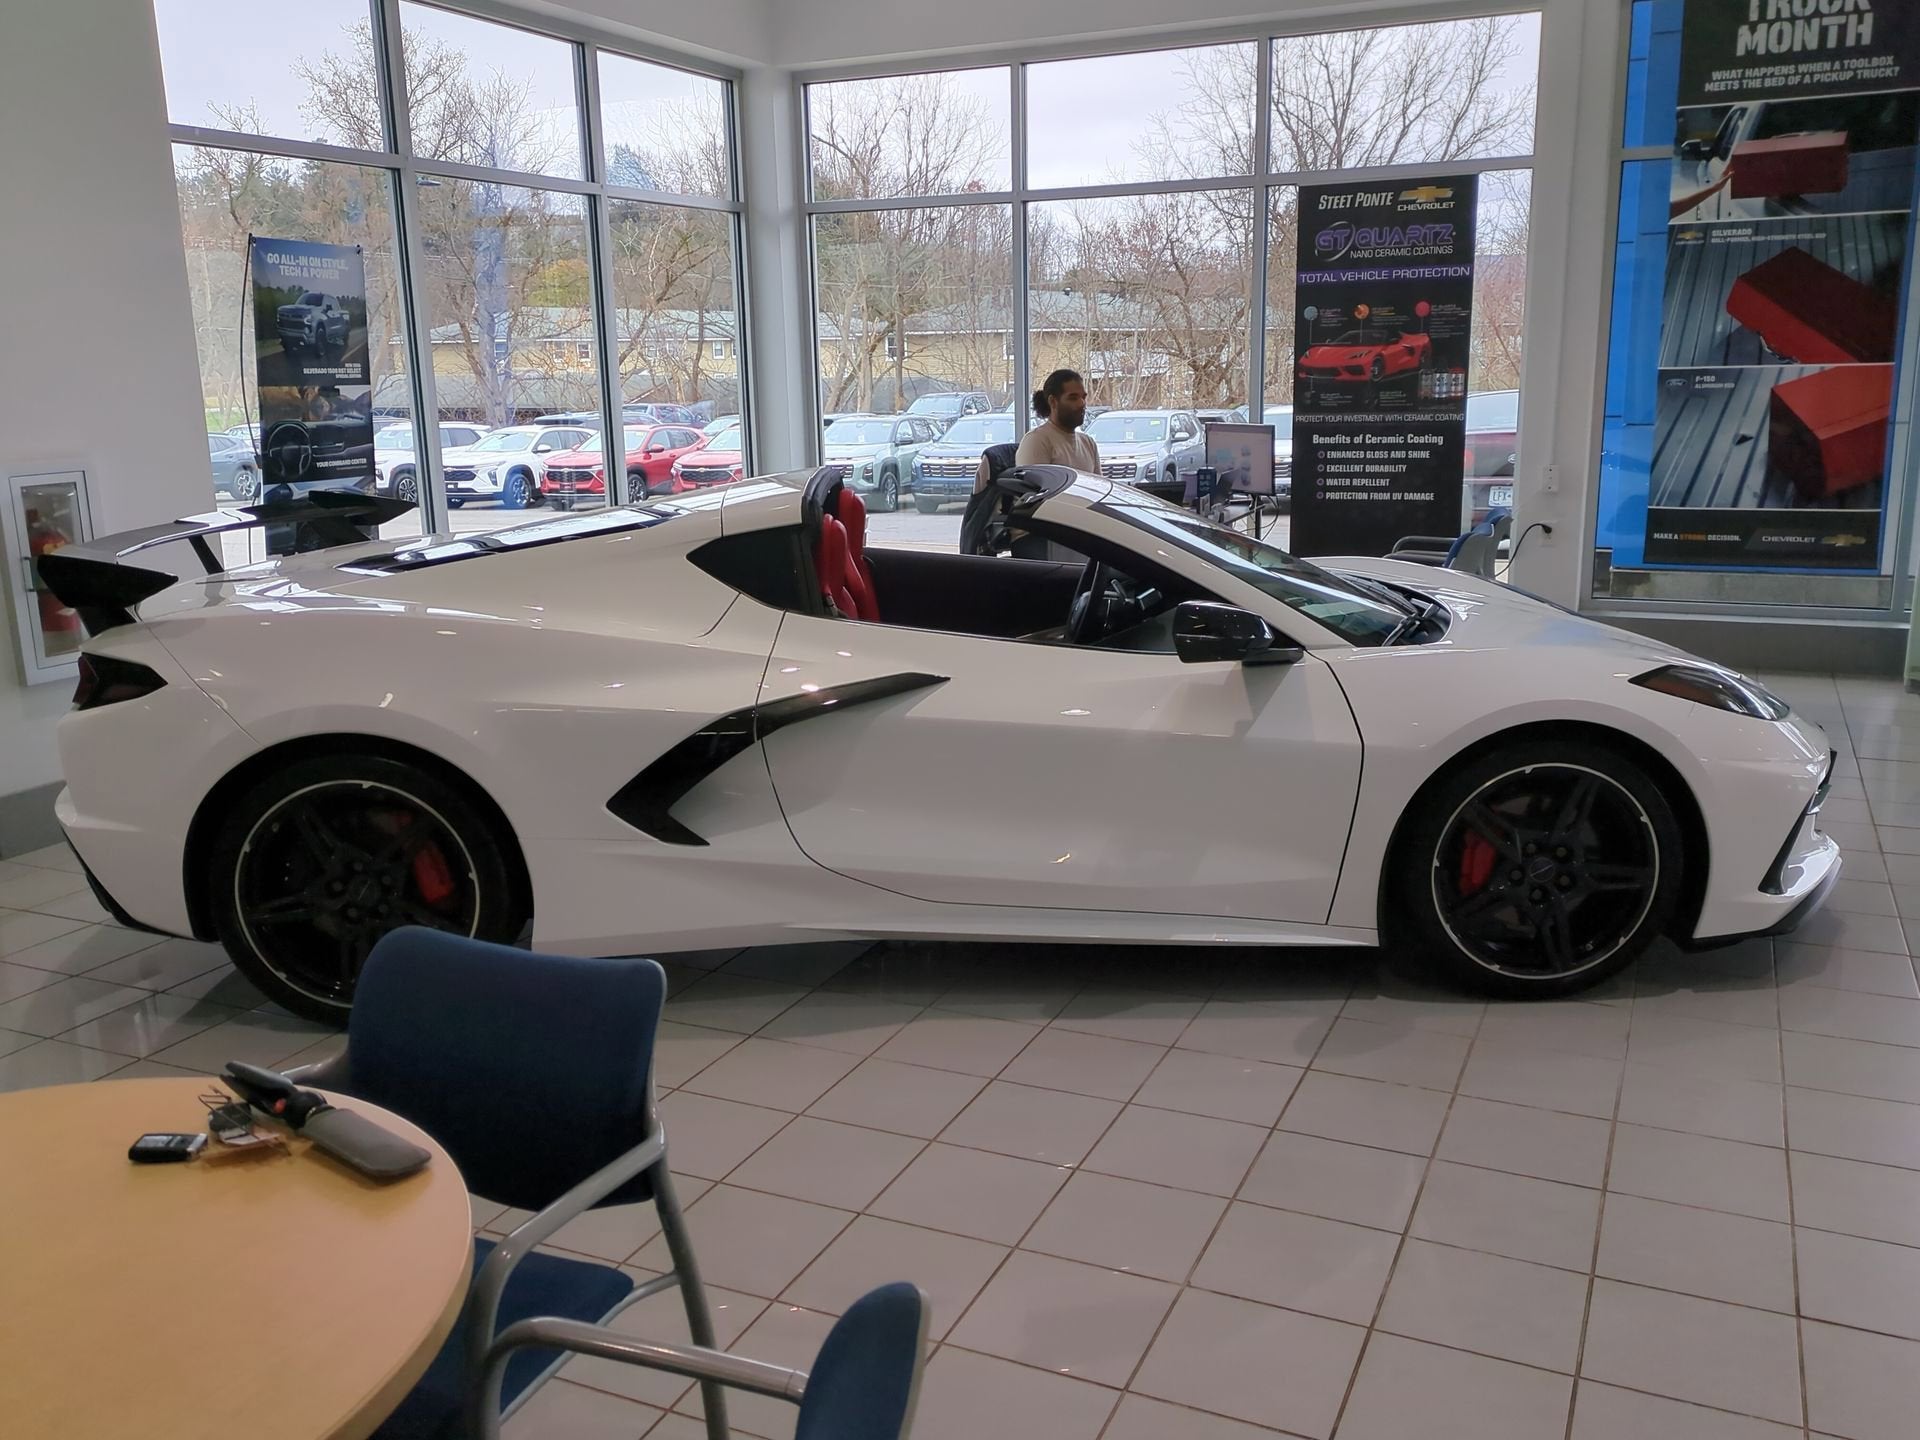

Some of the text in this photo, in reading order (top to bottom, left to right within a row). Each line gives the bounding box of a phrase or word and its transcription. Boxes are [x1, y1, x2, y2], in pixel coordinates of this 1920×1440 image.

[1736, 12, 1874, 56] MONTH
[1712, 56, 1894, 80] WHAT HAPPENS WHEN A TOOLBOX
[1705, 67, 1900, 92] MEETS THE BED OF A PICKUP TRUCK?
[1318, 192, 1394, 210] STEET PONTE
[1397, 202, 1455, 211] CHEVROLET
[1315, 224, 1454, 250] GT QUARTZ
[1712, 228, 1752, 237] SILVERADO
[1350, 246, 1453, 259] NANO CERAMIC COATINGS
[267, 253, 280, 264] GO
[281, 254, 308, 266] ALL-IN
[309, 256, 320, 267] ON
[280, 265, 300, 276] TECH
[310, 268, 339, 280] POWER
[1300, 267, 1470, 283] TOTAL VEHICLE PROTECTION
[1435, 413, 1464, 422] COATING
[1312, 434, 1444, 446] Benefits of Ceramic Coating
[1327, 451, 1364, 459] ENHANCED
[1366, 451, 1389, 459] GLOSS
[1326, 478, 1350, 486] WATER
